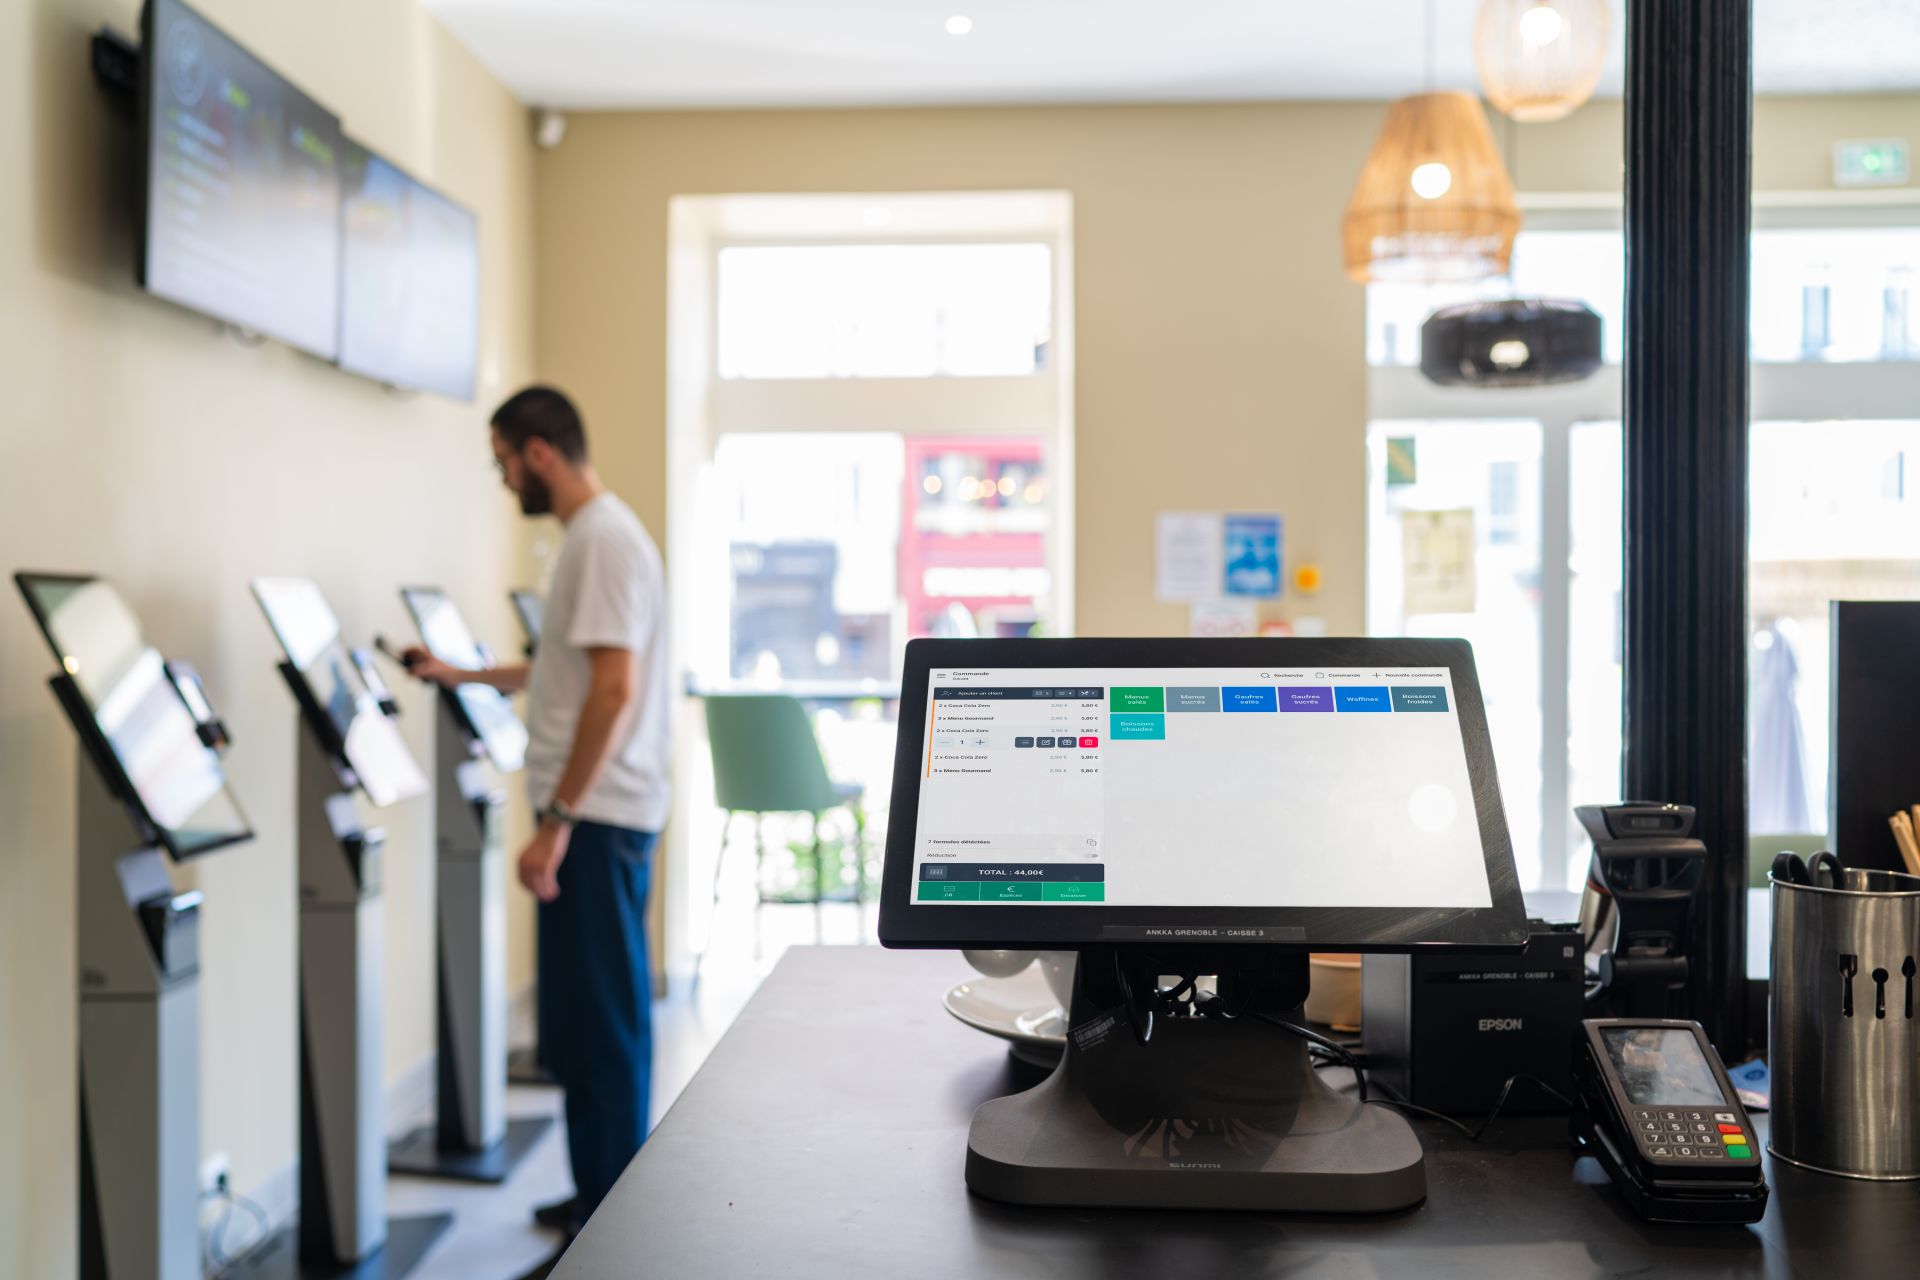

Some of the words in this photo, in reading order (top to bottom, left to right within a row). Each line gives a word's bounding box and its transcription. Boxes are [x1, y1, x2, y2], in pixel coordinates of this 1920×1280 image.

[1478, 1019, 1522, 1031] EPSON
[1667, 1112, 1675, 1120] 2
[1671, 1123, 1680, 1131] 5
[1651, 1134, 1659, 1142] 7
[1676, 1135, 1685, 1143] 8
[1702, 1135, 1711, 1143] 9
[1681, 1147, 1691, 1155] 0
